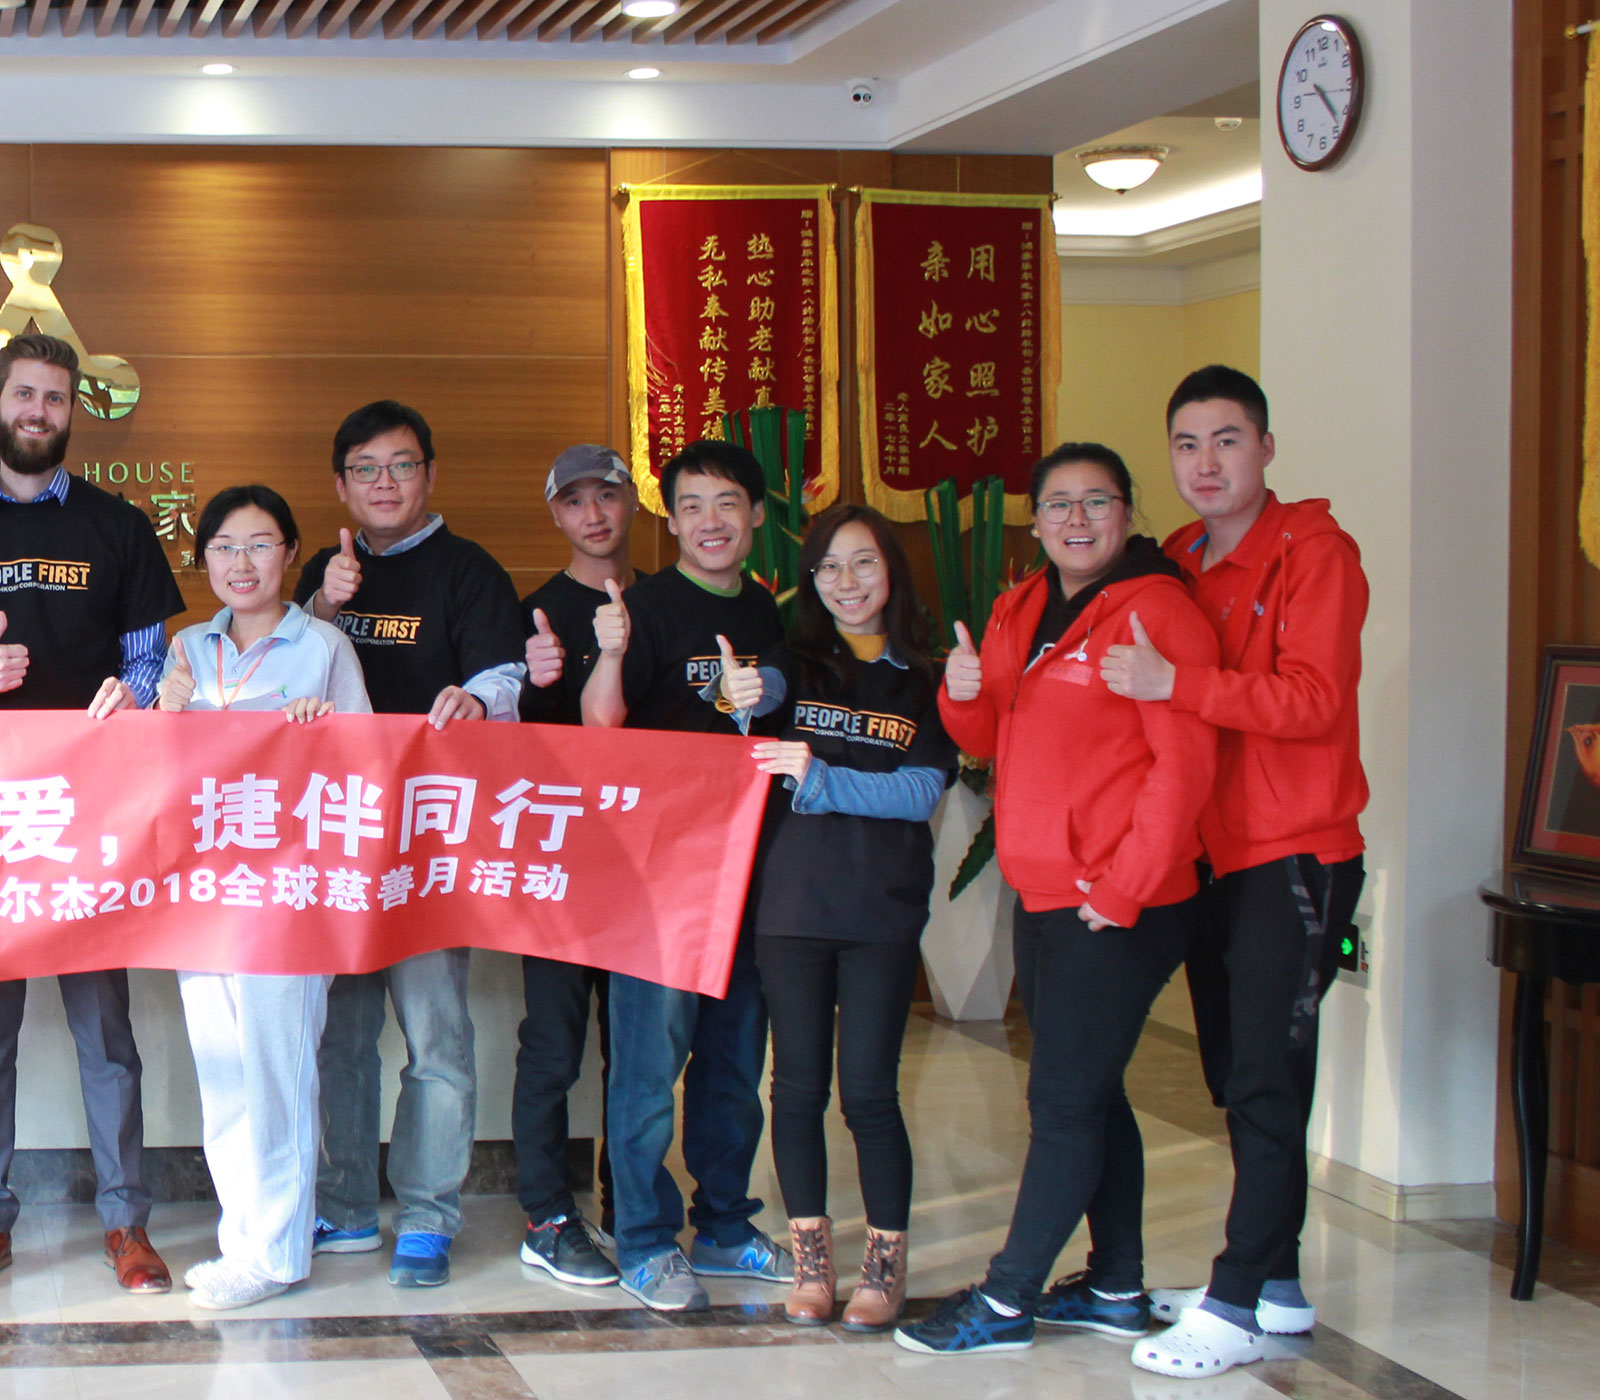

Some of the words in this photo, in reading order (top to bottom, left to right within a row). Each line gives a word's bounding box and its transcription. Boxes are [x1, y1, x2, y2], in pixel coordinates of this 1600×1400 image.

[1317, 36, 1329, 51] 12
[1305, 48, 1316, 62] 11
[1296, 69, 1308, 83] 10
[1293, 96, 1301, 109] 9
[1297, 119, 1305, 133] 8
[1332, 126, 1341, 140] 5
[1306, 133, 1314, 148] 7
[1319, 136, 1327, 150] 6
[698, 234, 730, 442] 无私奉献传美德
[918, 240, 958, 451] 亲如家人
[965, 244, 1000, 456] 用心照护
[84, 461, 195, 484] HOUSE
[38, 563, 90, 586] FIRST
[374, 620, 420, 640] FIRST
[794, 705, 862, 734] PEOPLE
[867, 716, 917, 747] FIRST
